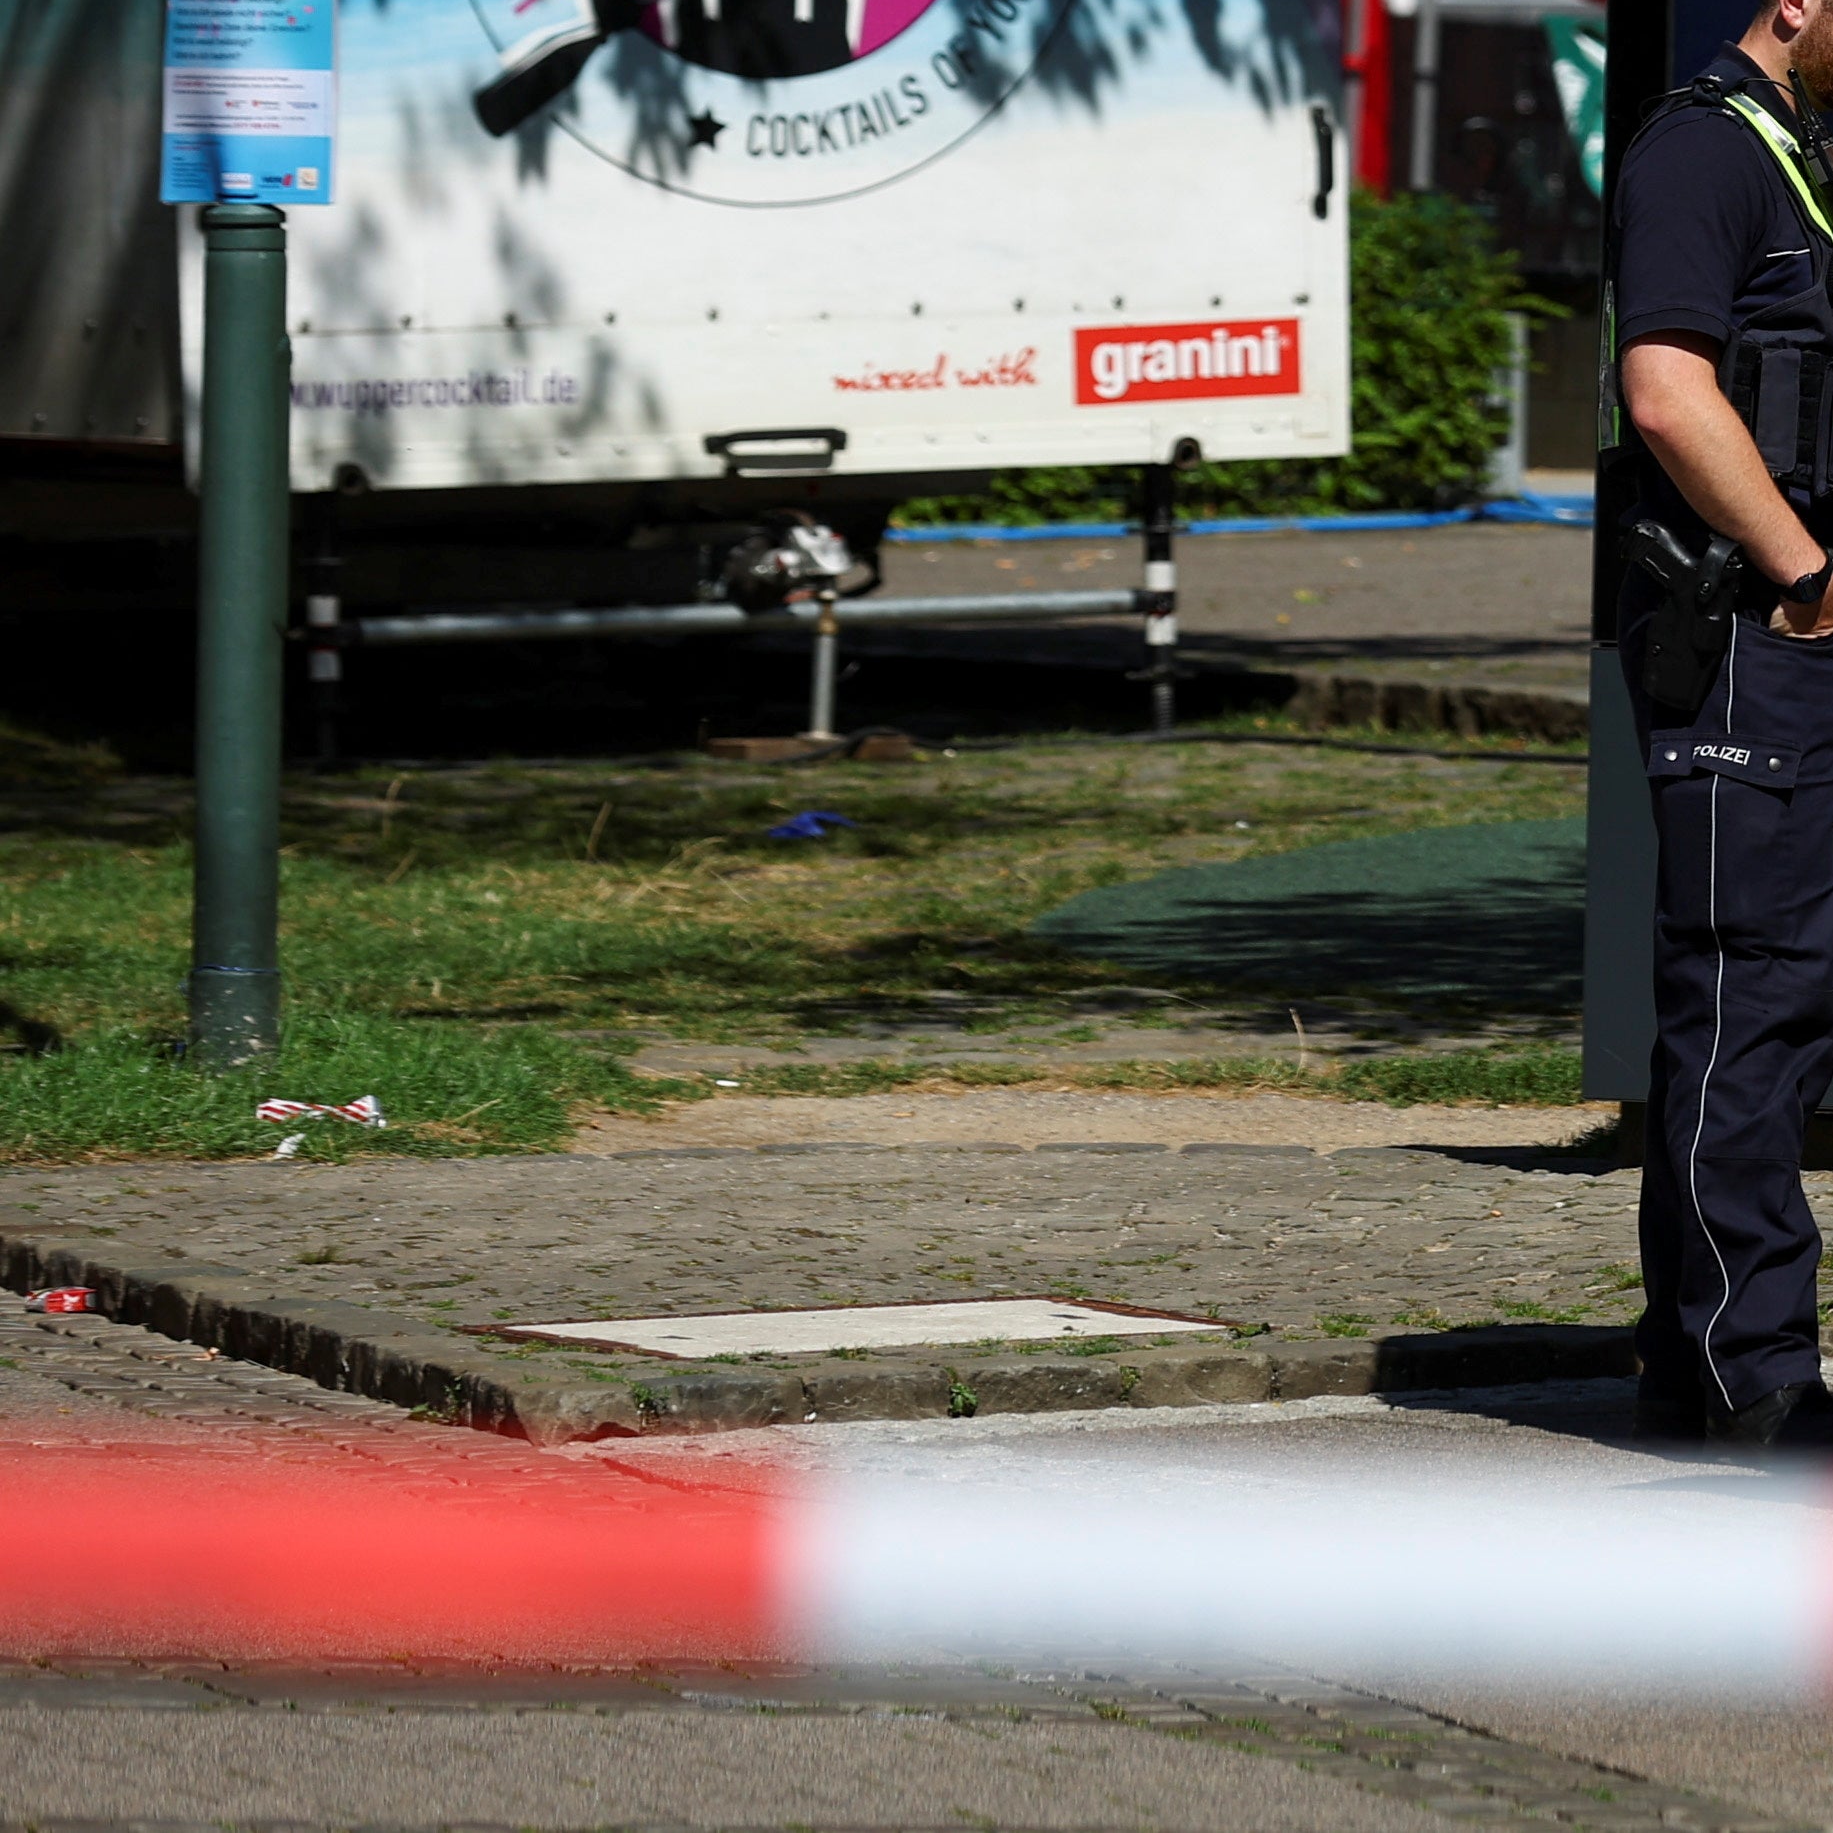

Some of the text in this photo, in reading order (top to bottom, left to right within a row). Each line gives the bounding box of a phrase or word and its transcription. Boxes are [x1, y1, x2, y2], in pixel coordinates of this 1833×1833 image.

[747, 75, 928, 157] COCKTAILS
[931, 33, 978, 90] OF
[832, 345, 1040, 393] mixed with
[1090, 325, 1282, 398] granini
[1692, 744, 1752, 766] POLIZEI
